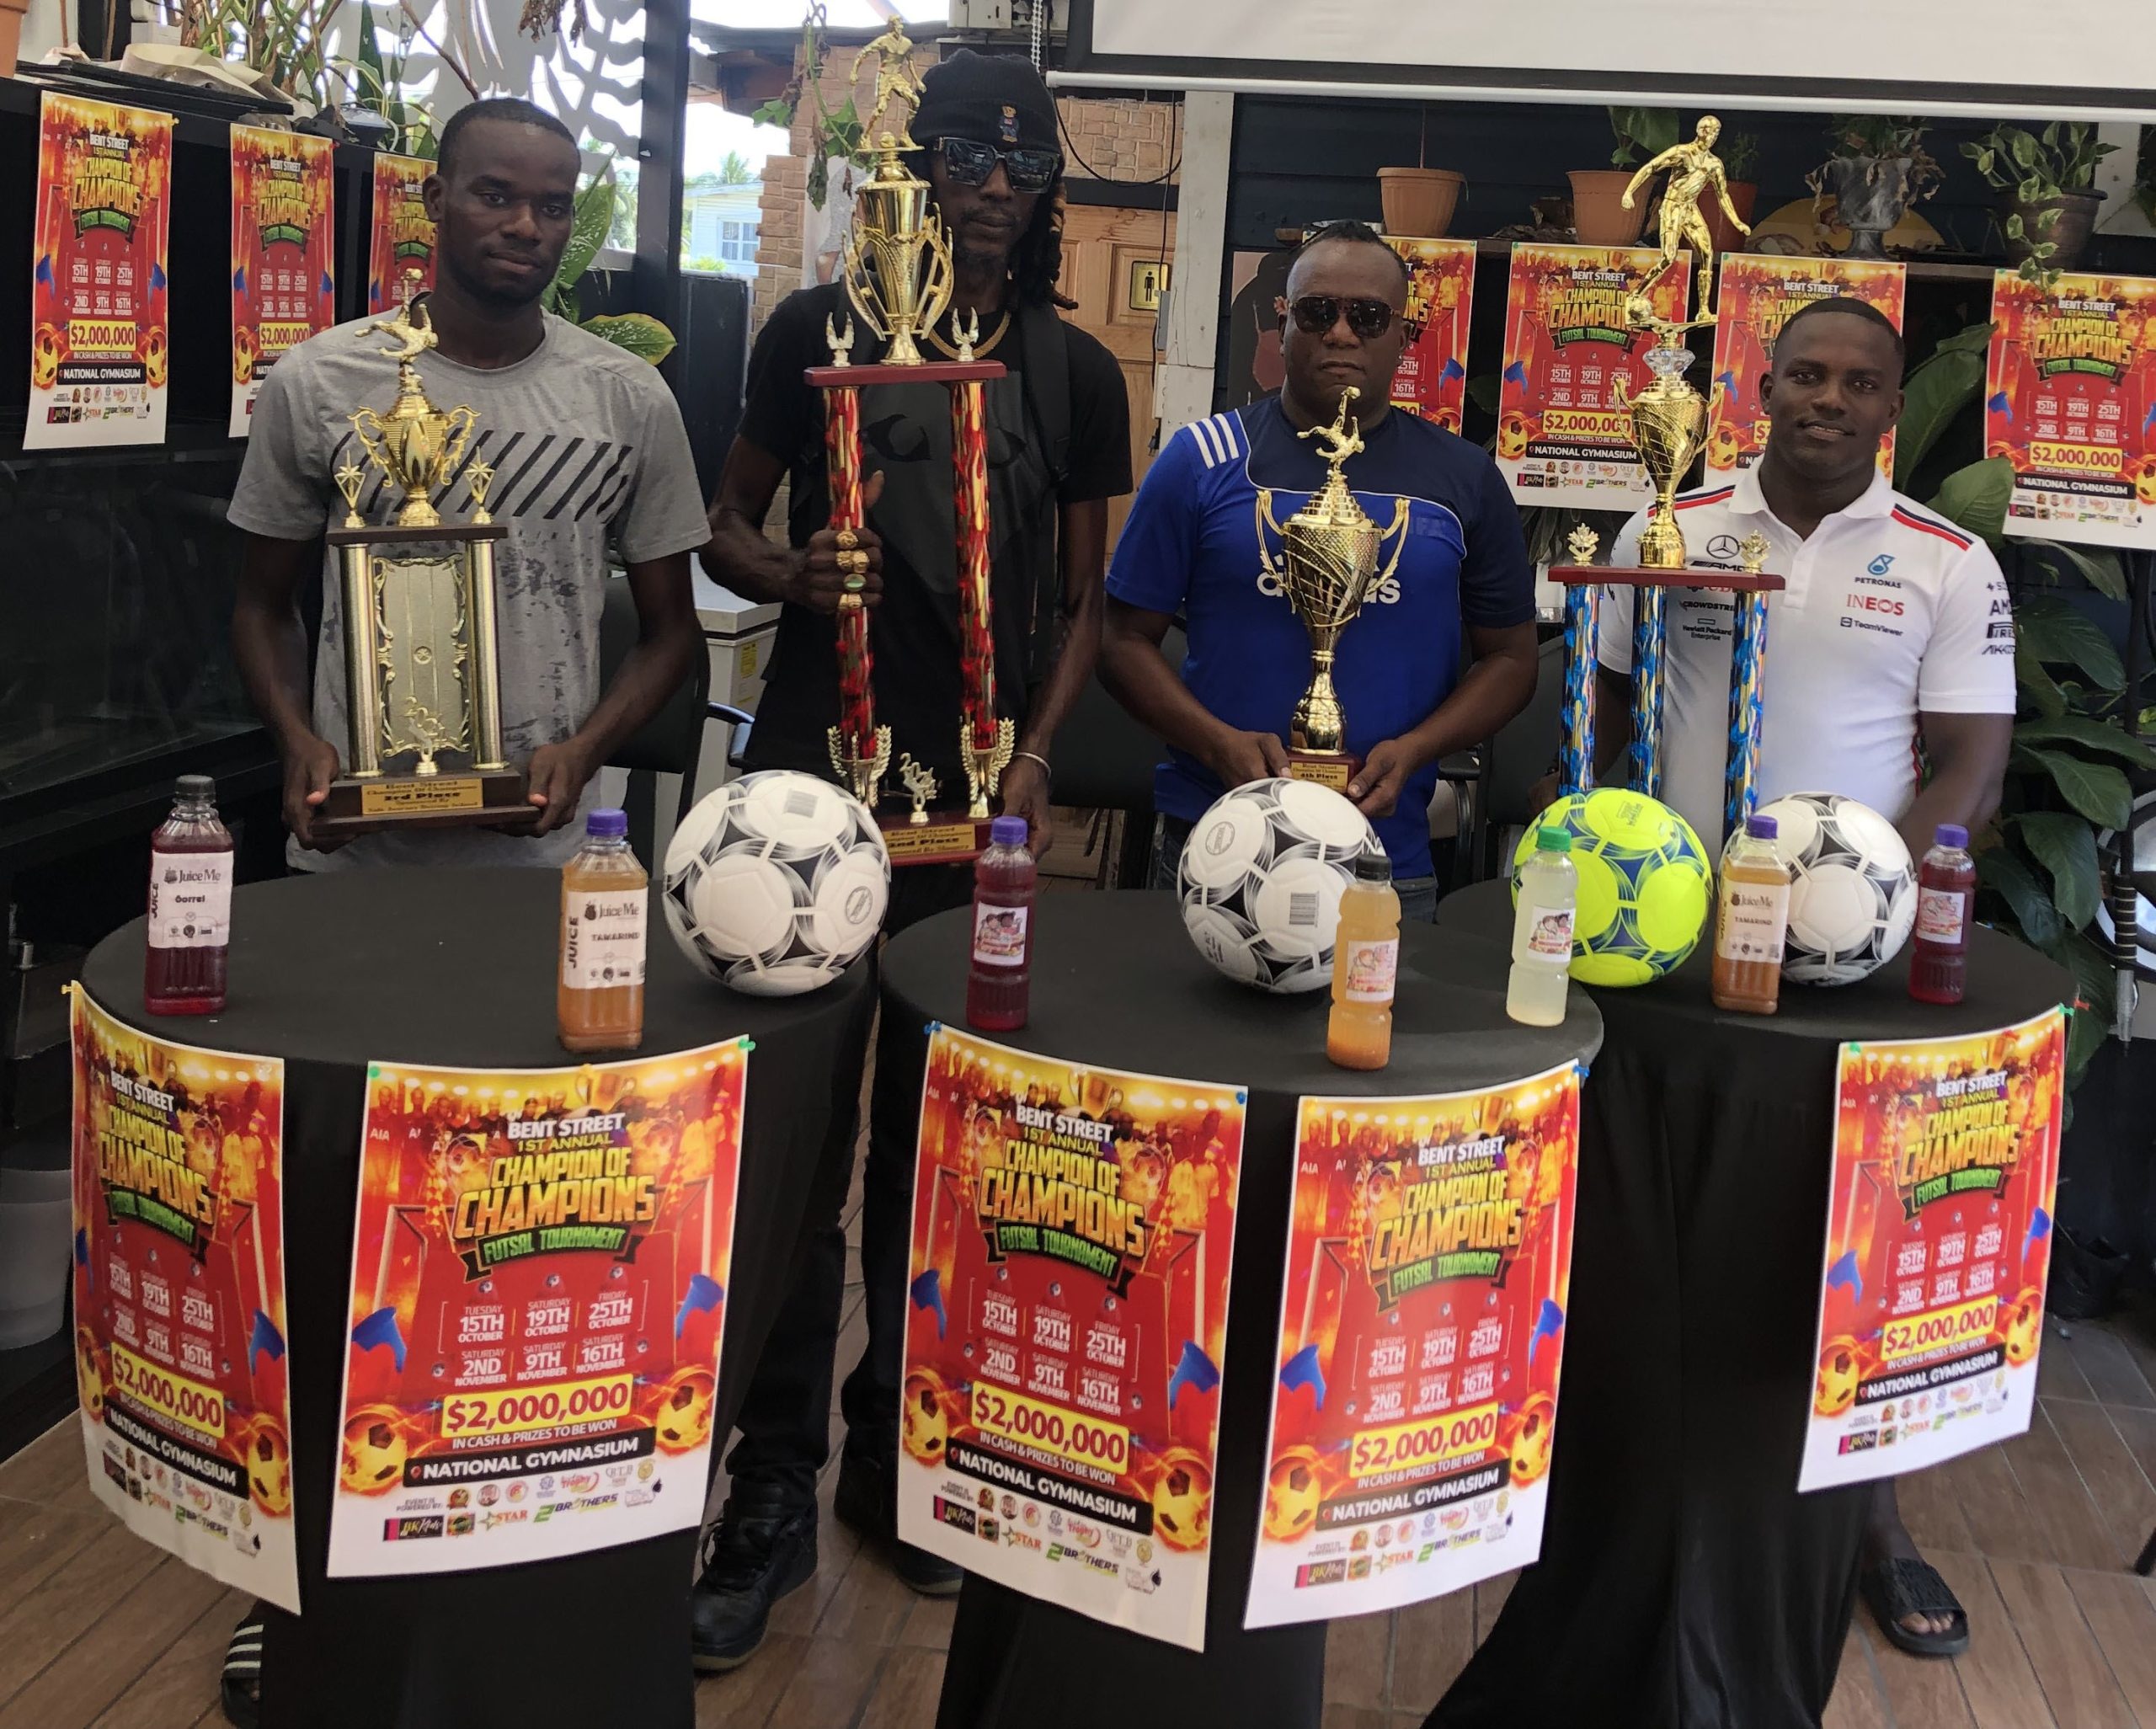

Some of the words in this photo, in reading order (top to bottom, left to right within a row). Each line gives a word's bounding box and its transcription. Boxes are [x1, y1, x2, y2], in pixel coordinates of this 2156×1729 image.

[89, 134, 105, 146] BENT
[106, 136, 129, 150] STREET
[72, 178, 141, 217] CHAMPIONS
[1572, 270, 1594, 280] BENT
[1594, 272, 1625, 281] STREET
[1565, 289, 1616, 305] CHAMPION
[1784, 282, 1806, 291] BENT
[1807, 283, 1839, 294] STREET
[2059, 301, 2081, 310] BENT
[2083, 302, 2116, 312] STREET
[71, 323, 135, 348] $2,000,000
[2033, 334, 2132, 364] CHAMPIONS
[64, 368, 99, 378] NATIONAL
[100, 369, 141, 378] GYMNASIUM
[1550, 369, 1572, 378] 15TH
[1581, 371, 1601, 380] 19TH
[1395, 383, 1415, 392] 16TH
[1552, 392, 1570, 402] 2ND
[1581, 394, 1598, 403] 9TH
[2098, 404, 2121, 415] 25TH
[1534, 446, 1580, 456] NATIONAL
[1581, 448, 1637, 460] GYMNASIUM
[2032, 446, 2120, 468] $2,000,000
[2023, 477, 2070, 490] NATIONAL
[2071, 480, 2127, 495] GYMNASIUM
[1854, 577, 1902, 589] PETRONAS
[1682, 600, 1734, 611] CROWDSTRI
[1846, 594, 1905, 616] INEOS
[1705, 627, 1732, 635] Packard
[1854, 620, 1904, 636] TeamViewer
[179, 869, 203, 883] Juice
[204, 869, 221, 881] Me
[600, 904, 622, 918] Juice
[623, 903, 639, 916] Me
[1741, 894, 1760, 906] Juice
[1759, 896, 1773, 908] Me
[1735, 916, 1772, 926] TAMARIND
[568, 916, 579, 969] JUICE
[591, 931, 640, 942] TAMARIND
[1937, 1079, 1967, 1098] BENT
[1967, 1070, 2008, 1091] STREET
[134, 1083, 174, 1112] STREET
[507, 1117, 557, 1139] BENT
[557, 1113, 626, 1134] STREET
[1017, 1103, 1054, 1128] BENT
[1055, 1115, 1114, 1143] STREET
[1926, 1104, 1993, 1139] CHAMPION
[1993, 1100, 2009, 1123] OF
[370, 1128, 389, 1140] AIA
[517, 1138, 549, 1153] 1ST
[550, 1132, 614, 1150] ANNUAL
[1023, 1126, 1048, 1140] 1ST
[1049, 1133, 1104, 1155] ANNUAL
[1418, 1145, 1457, 1166] BENT
[1457, 1136, 1505, 1161] STREET
[1898, 1123, 2020, 1186] CHAMPIONS
[491, 1149, 605, 1187] CHAMPION
[605, 1147, 632, 1176] OF
[1005, 1139, 1096, 1193] CHAMPION
[1097, 1159, 1121, 1195] OF
[99, 1132, 213, 1225] CHAMPIONS
[1403, 1173, 1488, 1217] CHAMPION
[1490, 1169, 1509, 1198] OF
[454, 1175, 656, 1239] CHAMPIONS
[979, 1167, 1147, 1257] CHAMPIONS
[1370, 1198, 1524, 1271] CHAMPIONS
[483, 1233, 536, 1263] FUTSAL
[538, 1229, 626, 1251] TOURNAMENT
[1000, 1225, 1039, 1251] FUTSAL
[1043, 1230, 1118, 1277] TOURNAMENT
[1939, 1239, 1966, 1257] 19TH
[1393, 1262, 1434, 1292] FUTSAL
[1437, 1251, 1501, 1279] TOURNAMENT
[1969, 1268, 1994, 1287] 16TH
[599, 1291, 627, 1301] FRIDAY
[1898, 1287, 1922, 1304] 2ND
[1937, 1278, 1957, 1296] 9TH
[182, 1295, 213, 1321] 25TH
[465, 1305, 503, 1315] TUESDAY
[528, 1298, 571, 1310] SATURDAY
[590, 1298, 633, 1319] 25TH
[983, 1300, 1017, 1326] 15TH
[460, 1314, 504, 1333] 15TH
[526, 1307, 570, 1326] 19TH
[589, 1315, 631, 1329] OCTOBER
[458, 1331, 504, 1342] OCTOBER
[525, 1324, 568, 1337] OCTOBER
[1034, 1315, 1070, 1342] 19TH
[1470, 1324, 1502, 1347] 25TH
[1886, 1304, 1994, 1355] $2,000,000
[524, 1342, 566, 1354] SATURDAY
[583, 1333, 624, 1346] SATURDAY
[1087, 1330, 1126, 1356] 25TH
[1423, 1335, 1457, 1357] 19TH
[182, 1342, 212, 1369] 16TH
[462, 1348, 505, 1358] SATURDAY
[526, 1351, 562, 1371] 9TH
[582, 1342, 624, 1363] 16TH
[986, 1347, 1016, 1373] 2ND
[1371, 1344, 1406, 1367] 15TH
[463, 1358, 501, 1375] 2ND
[517, 1367, 568, 1380] NOVEMBER
[576, 1358, 625, 1374] NOVEMBER
[1035, 1363, 1065, 1388] 9TH
[1867, 1371, 1929, 1399] NATIONAL
[1930, 1351, 1998, 1383] GYMNASIUM
[114, 1351, 221, 1427] $2,000,000
[455, 1374, 506, 1386] NOVEMBER
[1463, 1370, 1493, 1394] 16TH
[1081, 1378, 1119, 1404] 16TH
[1371, 1391, 1401, 1412] 2ND
[1421, 1381, 1449, 1404] 9TH
[446, 1383, 628, 1432] $2,000,000
[453, 1439, 465, 1449] IN
[467, 1436, 500, 1448] CASH
[501, 1436, 510, 1444] &
[513, 1430, 552, 1444] PRIZES
[555, 1427, 569, 1437] TO
[571, 1424, 586, 1434] BE
[589, 1419, 616, 1433] WON
[975, 1388, 1125, 1464] $2,000,000
[109, 1408, 161, 1449] NATIONAL
[160, 1440, 237, 1487] GYMNASIUM
[1354, 1412, 1494, 1471] $2,000,000
[423, 1456, 521, 1479] NATIONAL
[526, 1437, 638, 1469] GYMNASIUM
[958, 1451, 1035, 1491] NATIONAL
[1038, 1476, 1137, 1523] GYMNASIUM
[1332, 1495, 1412, 1522] NATIONAL
[1414, 1468, 1498, 1506] GYMNASIUM
[497, 1509, 528, 1523] STAR
[534, 1504, 556, 1523] 2
[555, 1493, 618, 1513] BROTHERS
[1013, 1531, 1042, 1550] STAR
[1046, 1543, 1065, 1561] 2
[1063, 1546, 1119, 1575] BROTHERS
